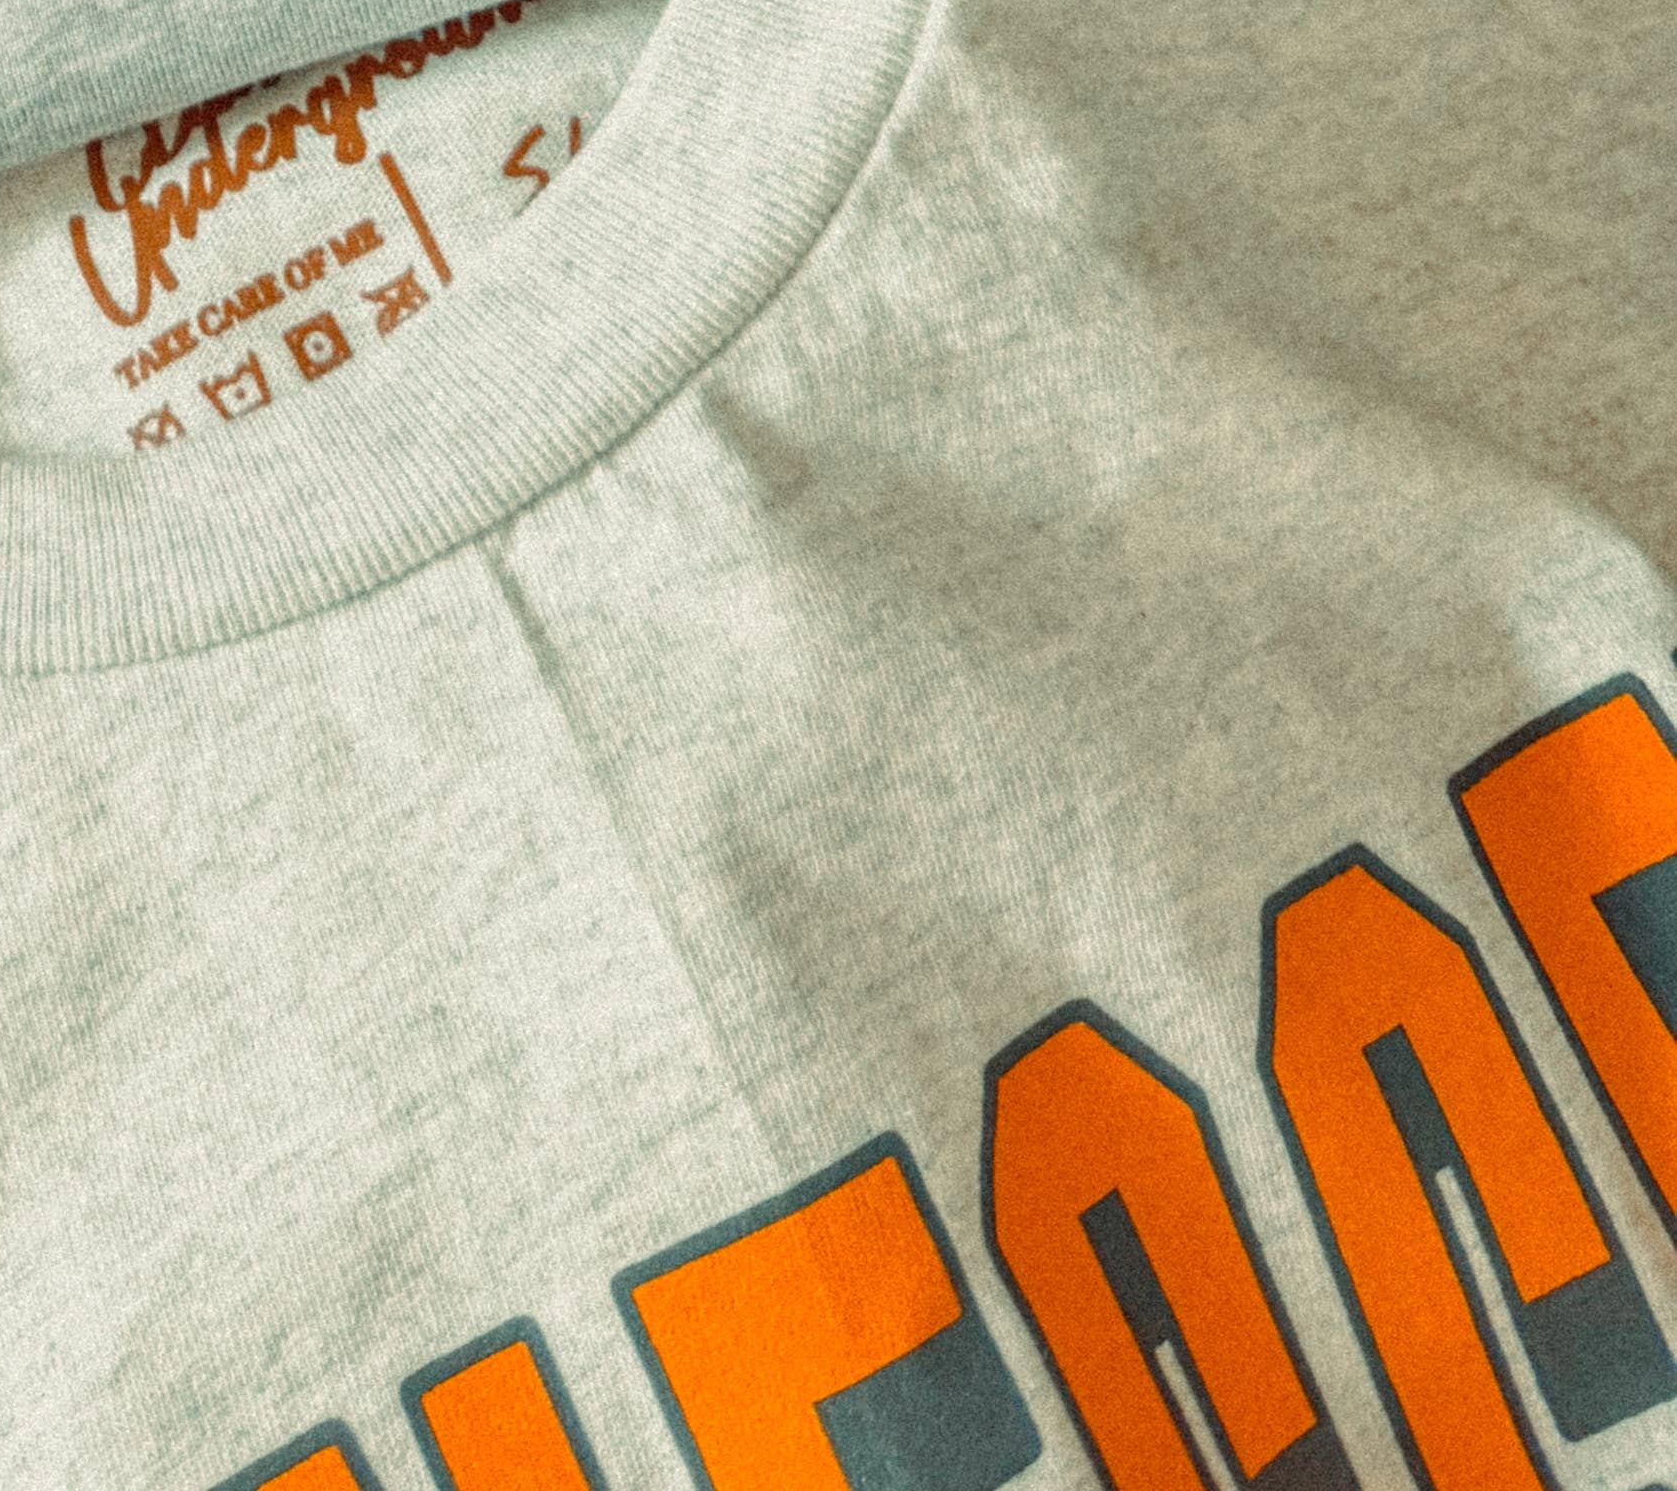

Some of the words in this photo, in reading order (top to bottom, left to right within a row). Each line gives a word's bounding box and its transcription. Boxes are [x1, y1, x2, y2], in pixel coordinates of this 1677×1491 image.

[114, 322, 199, 389] TAKE
[197, 273, 285, 337] CARE
[283, 246, 327, 290] OF
[328, 217, 385, 267] ME
